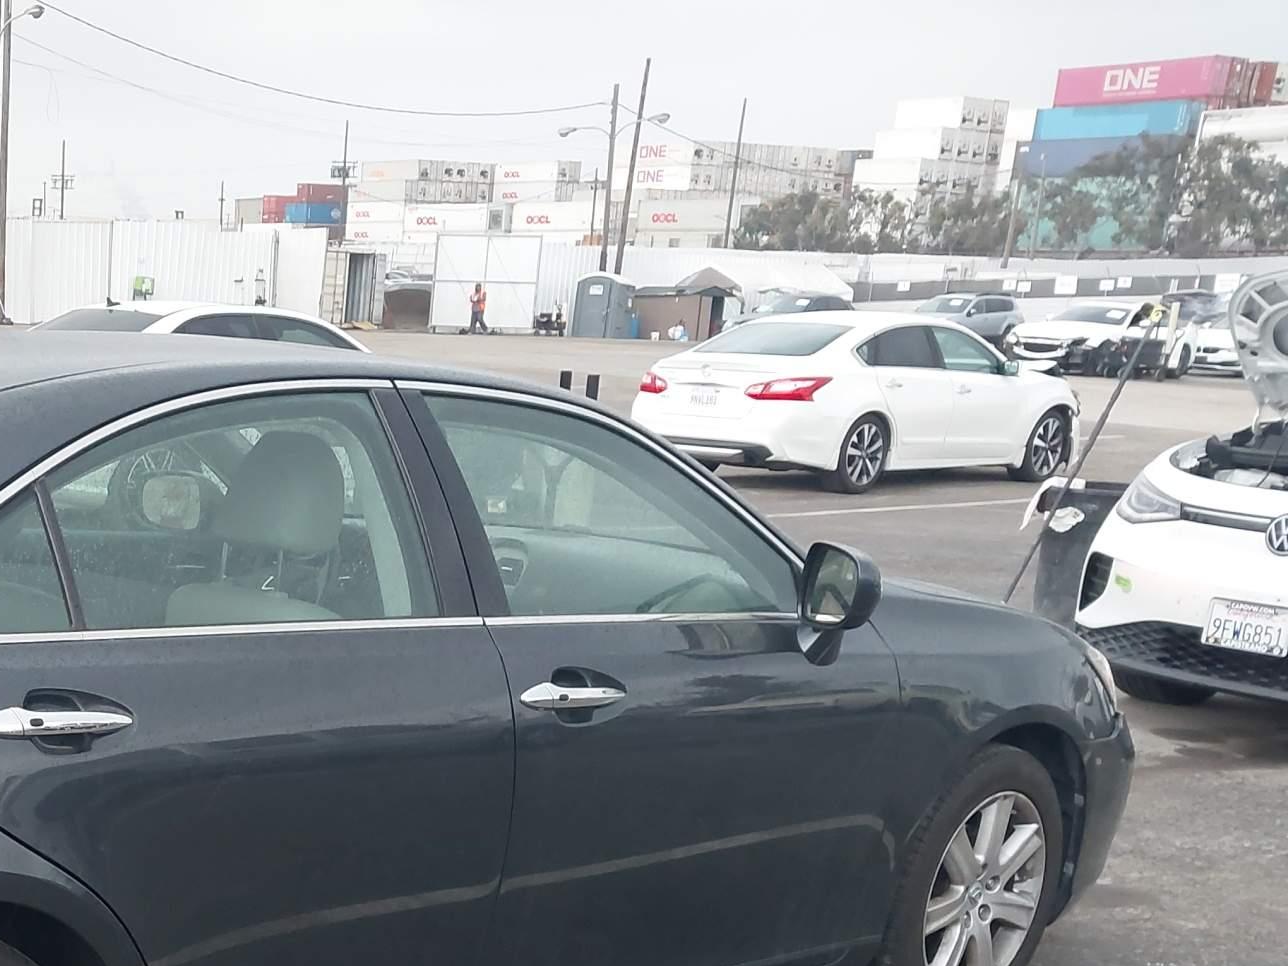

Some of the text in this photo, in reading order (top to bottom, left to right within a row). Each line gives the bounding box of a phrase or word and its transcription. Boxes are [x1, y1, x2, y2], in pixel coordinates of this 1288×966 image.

[1103, 66, 1161, 91] ONE
[639, 145, 667, 158] ONE
[636, 169, 664, 183] ONE
[416, 216, 438, 225] OOCL
[526, 215, 551, 224] OOCL
[652, 213, 678, 223] OOCL
[1212, 617, 1282, 647] 9FWG851
